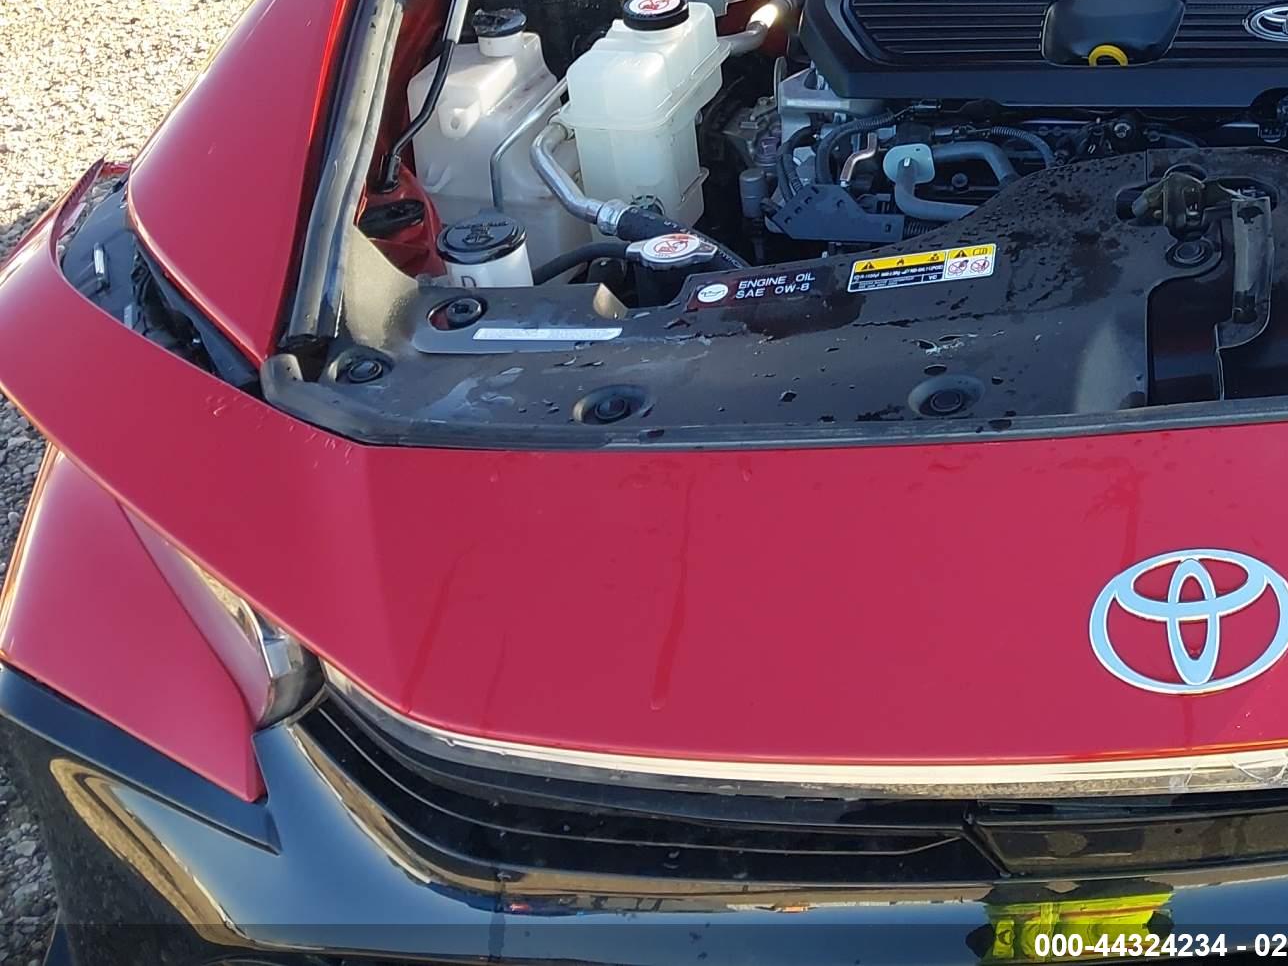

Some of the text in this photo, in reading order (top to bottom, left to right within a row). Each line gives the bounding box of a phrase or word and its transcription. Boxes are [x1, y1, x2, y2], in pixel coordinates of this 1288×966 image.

[738, 272, 816, 290] ENGINE OIL
[735, 282, 810, 299] SAE 0W-8
